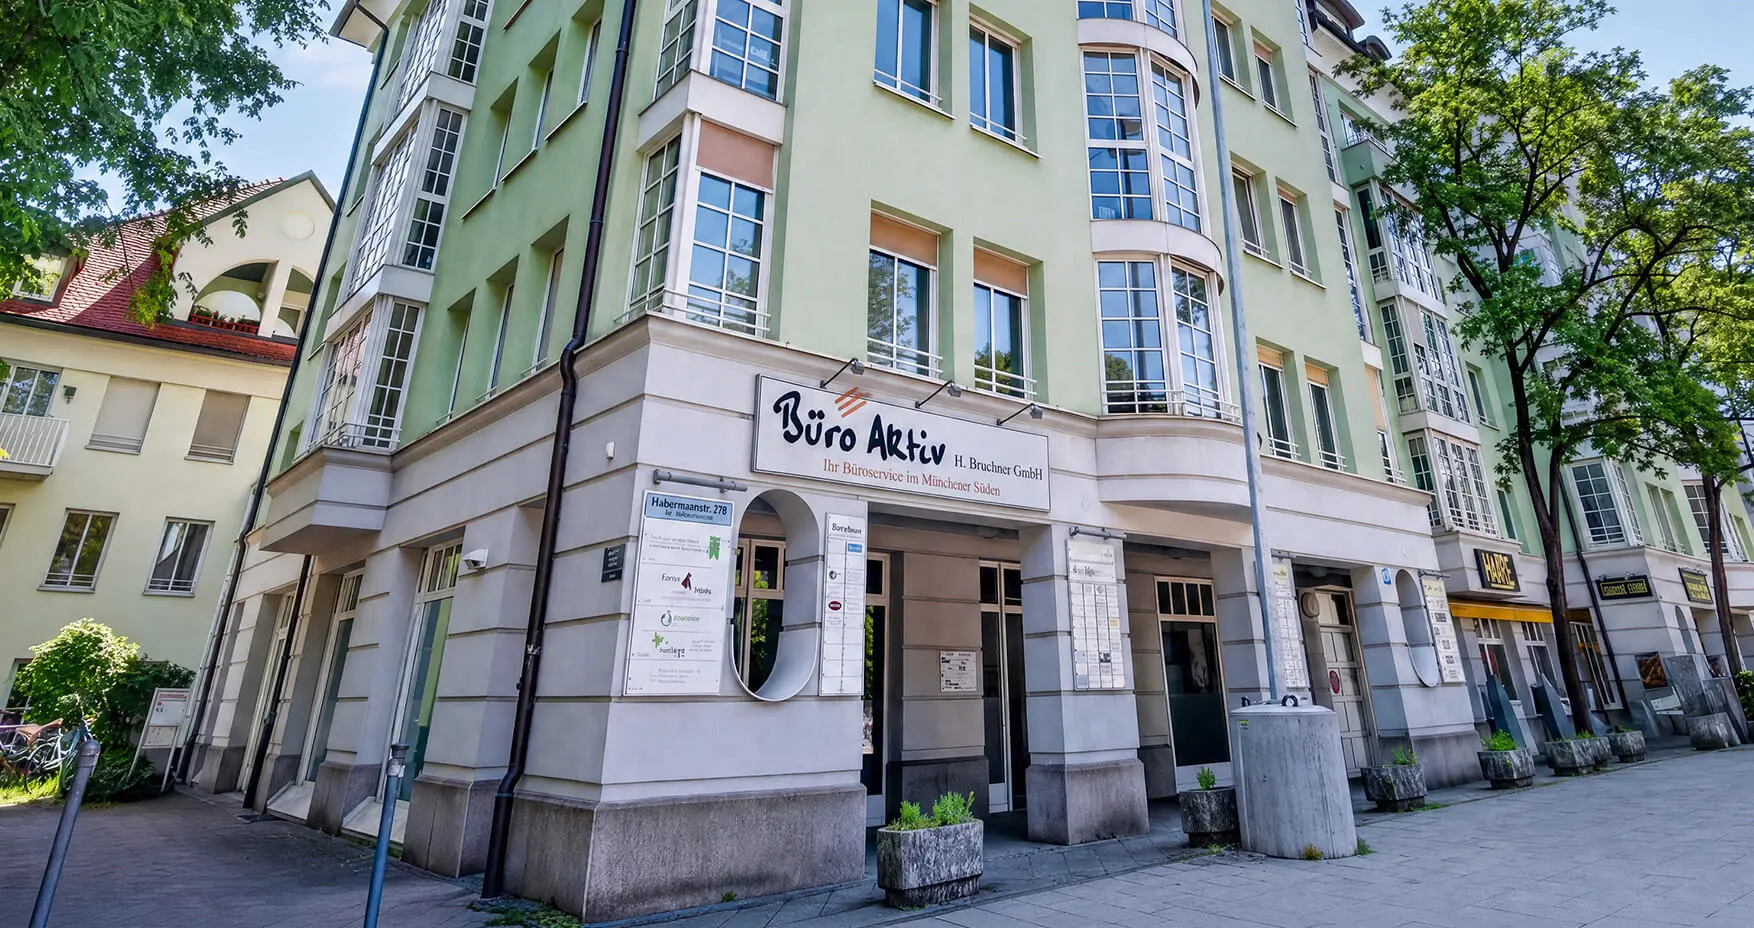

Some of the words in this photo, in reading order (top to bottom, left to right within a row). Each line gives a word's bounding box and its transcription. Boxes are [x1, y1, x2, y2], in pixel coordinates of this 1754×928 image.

[773, 391, 857, 452] Büro
[954, 454, 966, 468] H.
[969, 457, 1011, 475] Bruchner
[1013, 464, 1043, 481] GmbH
[823, 458, 840, 473] Ihr
[843, 463, 903, 483] Büroservice
[906, 471, 919, 485] im
[921, 473, 971, 493] Münchener
[973, 482, 1001, 497] Süden
[713, 504, 728, 516] 278
